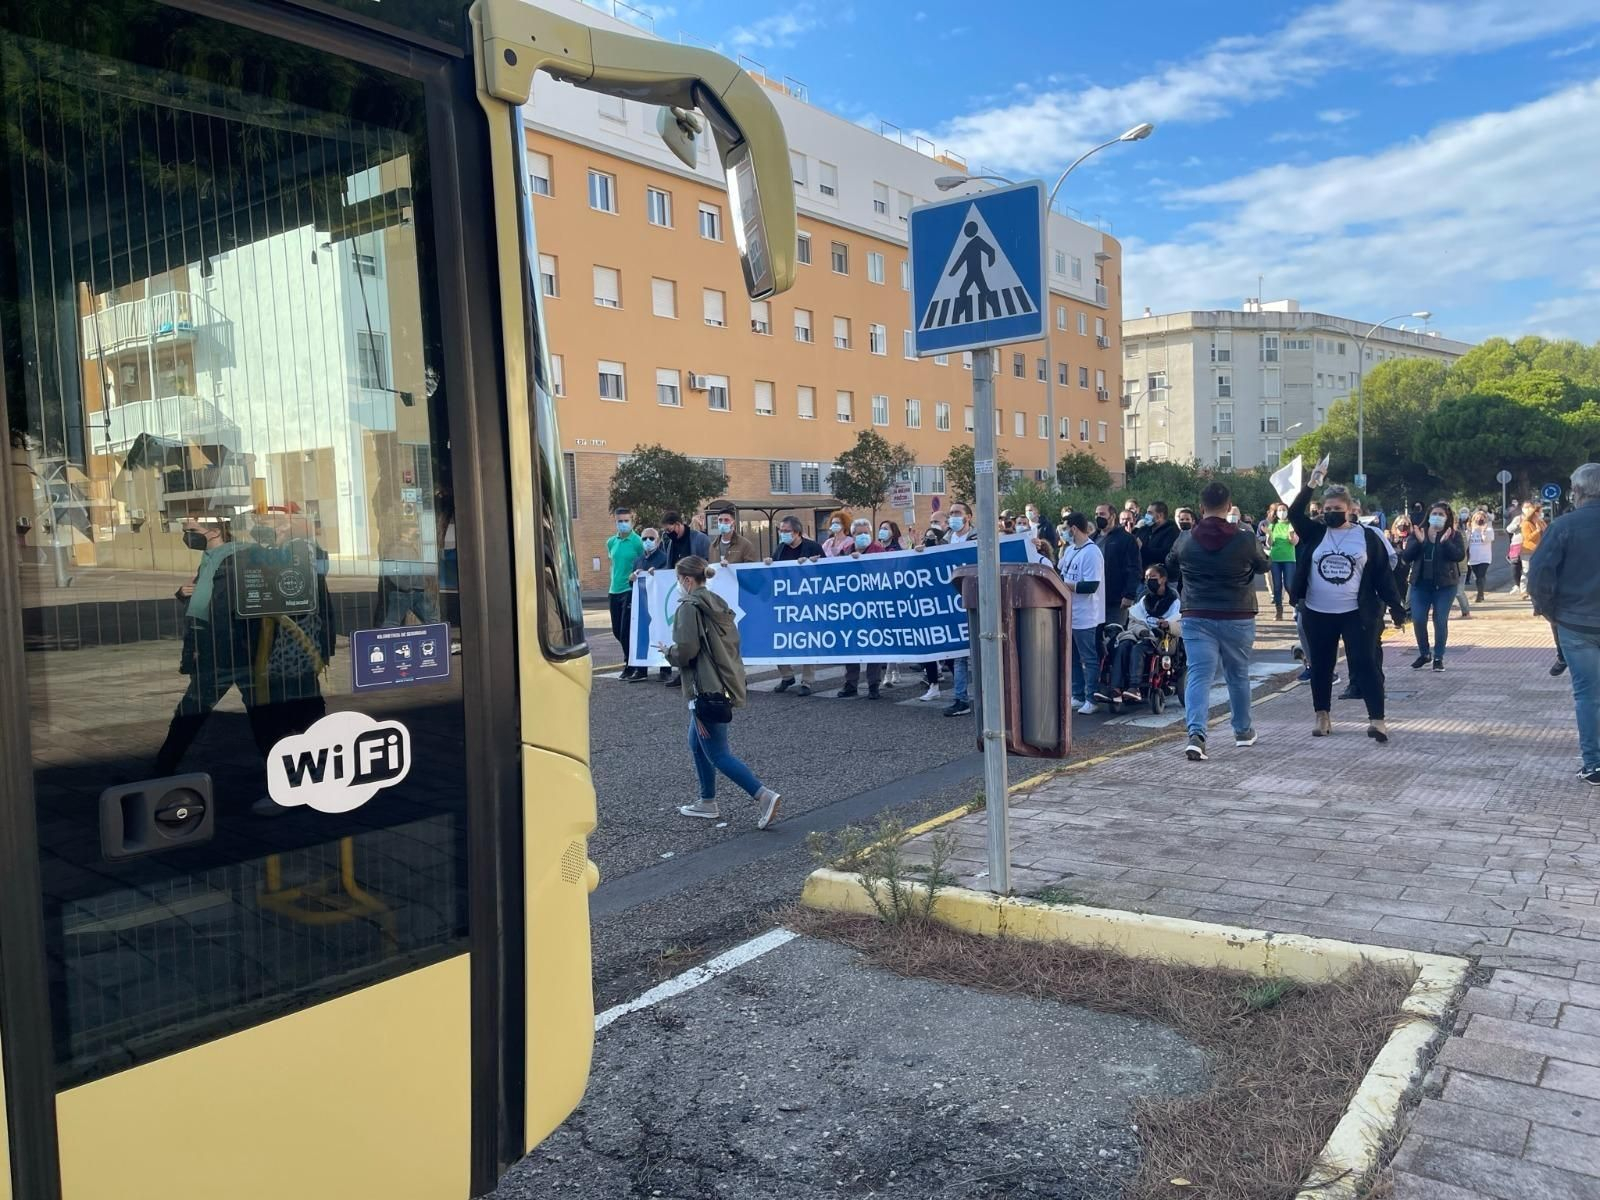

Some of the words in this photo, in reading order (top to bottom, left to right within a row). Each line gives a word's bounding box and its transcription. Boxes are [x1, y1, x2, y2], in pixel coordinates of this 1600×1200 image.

[773, 572, 893, 597] PLATAFORMA
[894, 568, 934, 590] POR
[773, 600, 896, 623] TRANSPORTE
[773, 630, 837, 650] DIGNO
[840, 630, 853, 648] Y
[856, 622, 969, 648] SOSTENIBLE
